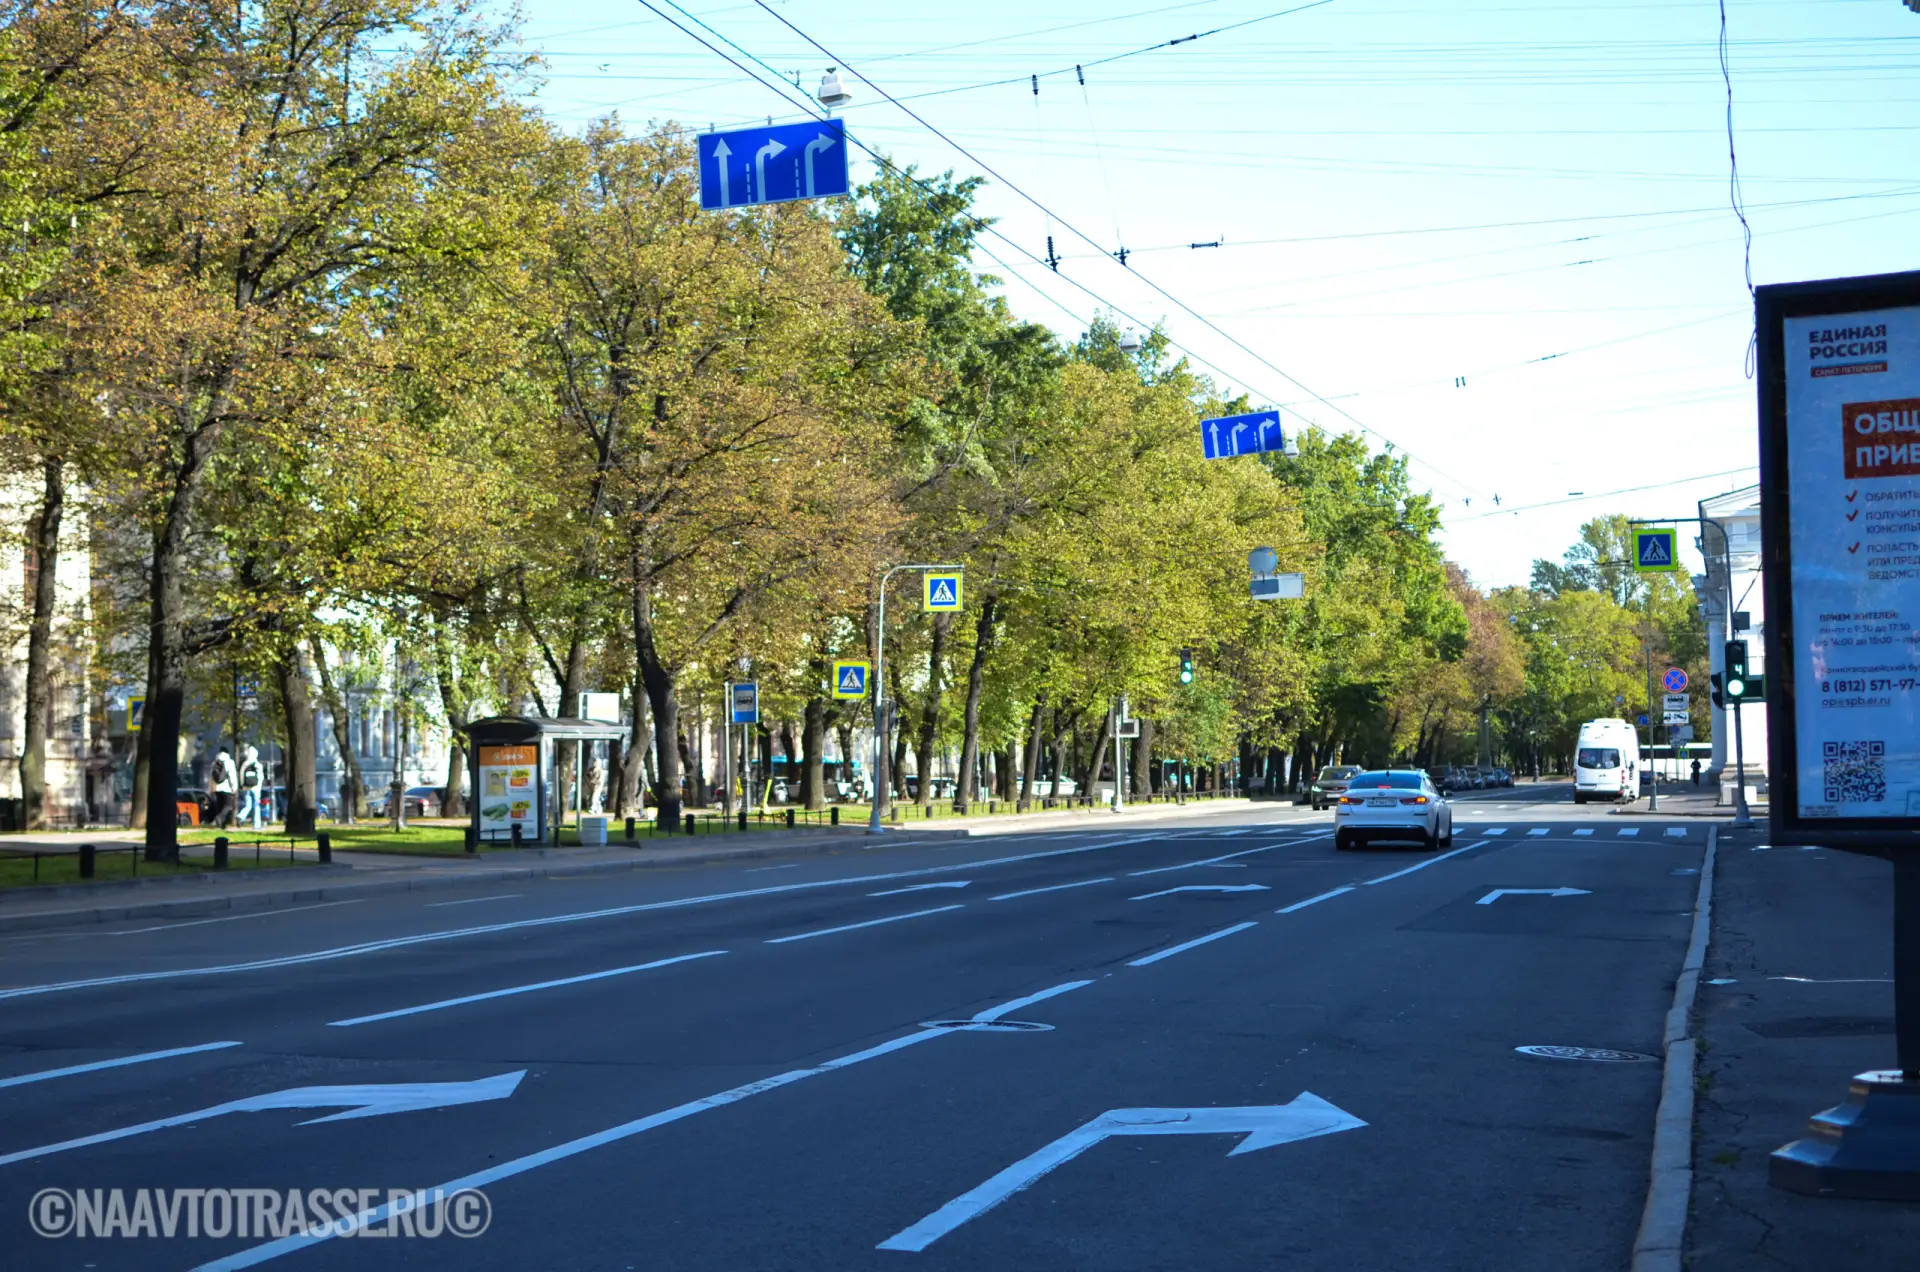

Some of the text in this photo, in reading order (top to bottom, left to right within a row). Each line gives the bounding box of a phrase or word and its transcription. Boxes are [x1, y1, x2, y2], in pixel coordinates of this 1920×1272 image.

[1809, 324, 1887, 344] ЕДИНАЯ
[1809, 340, 1888, 360] РОССИЯ
[1854, 410, 1920, 435] ОБЩ
[1855, 442, 1920, 469] ПРИЕ
[1867, 542, 1919, 554] ПОПАСТЬ
[1821, 680, 1830, 693] 8
[1834, 678, 1866, 694] (812)
